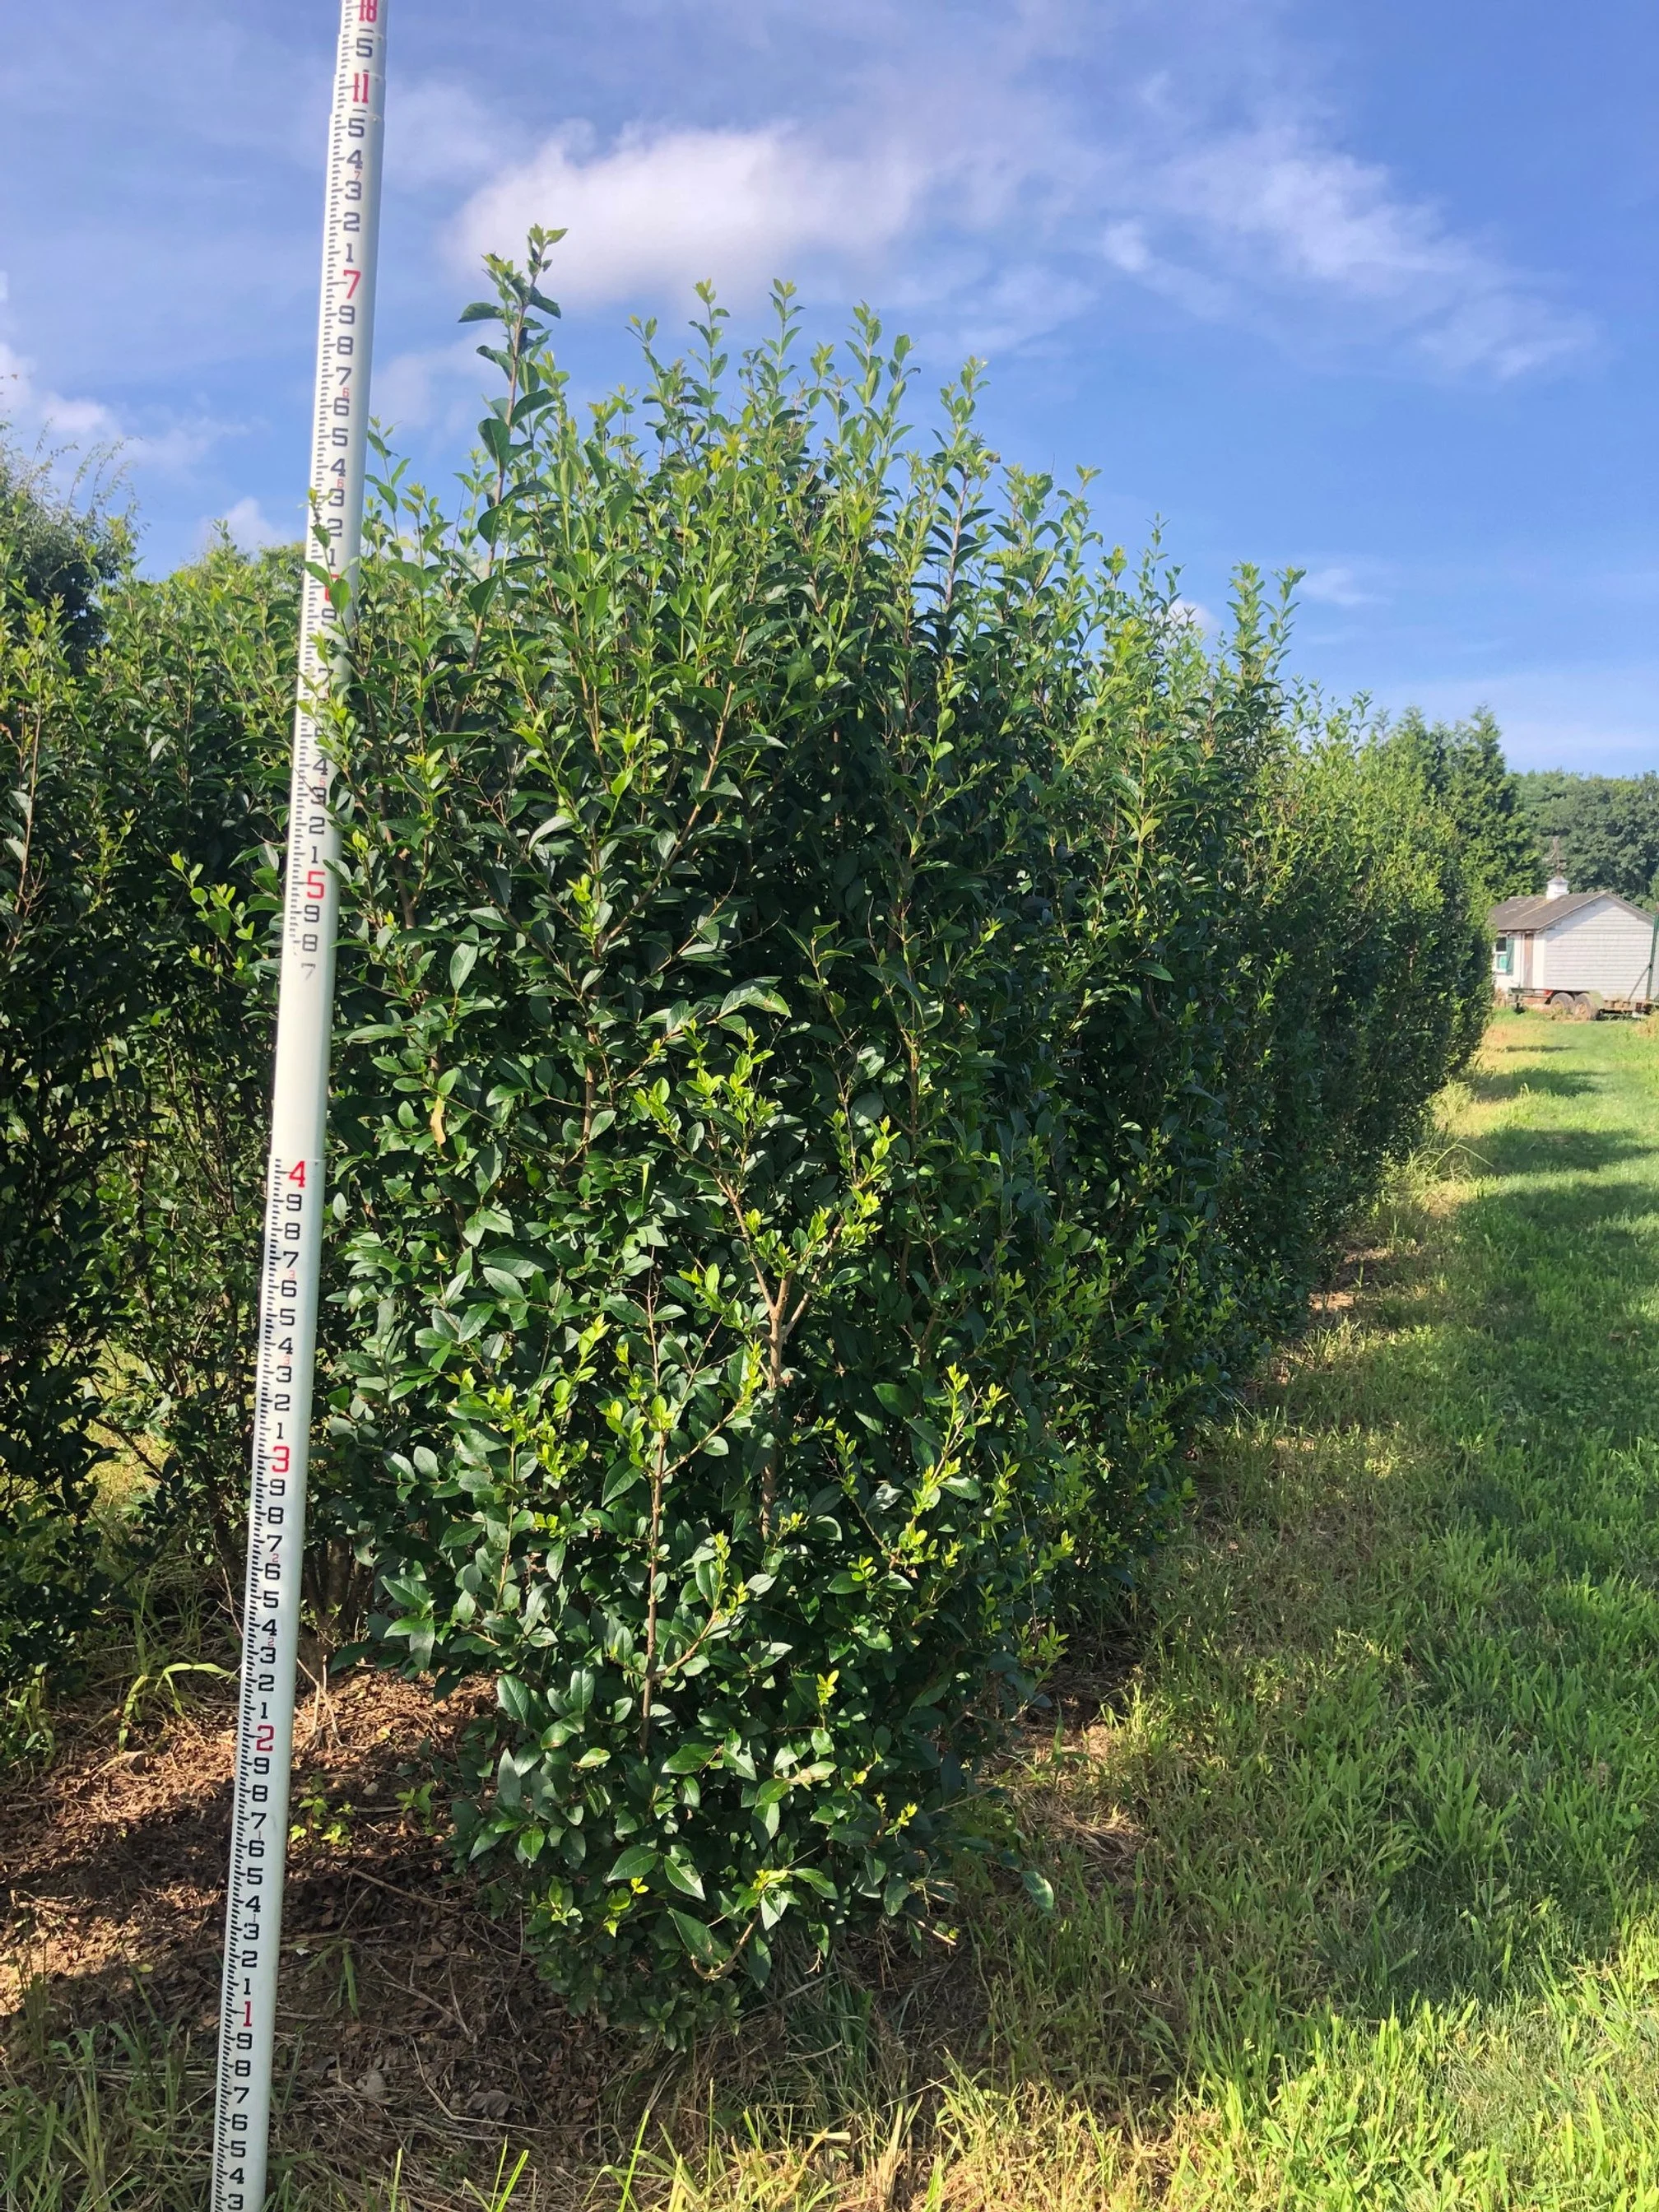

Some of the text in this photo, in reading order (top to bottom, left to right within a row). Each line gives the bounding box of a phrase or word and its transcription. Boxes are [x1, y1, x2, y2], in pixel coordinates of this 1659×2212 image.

[356, 38, 373, 58] 5
[353, 73, 369, 103] 11
[348, 118, 365, 137] 5
[346, 150, 363, 170] 4
[346, 180, 361, 201] 3
[343, 211, 360, 232] 2
[346, 243, 353, 263] 1
[343, 270, 360, 299] 7
[338, 304, 356, 325] 9
[337, 336, 354, 356] 8
[336, 367, 351, 385] 7
[342, 388, 350, 397] 6
[333, 397, 350, 416] 6
[332, 427, 348, 446] 5
[330, 458, 346, 476] 4
[328, 488, 344, 506] 3
[327, 518, 342, 537] 2
[328, 549, 336, 566] 1
[313, 756, 328, 775] 4
[309, 816, 325, 834] 2
[312, 846, 318, 863] 1
[306, 871, 325, 899] 5
[304, 905, 319, 922] 9
[302, 933, 318, 951] 8
[300, 963, 316, 981] 7
[289, 1160, 305, 1187] 4
[286, 1193, 302, 1211] 9
[285, 1222, 300, 1240] 8
[283, 1251, 299, 1268] 7
[281, 1280, 297, 1298] 6
[280, 1308, 295, 1326] 5
[278, 1337, 293, 1355] 4
[276, 1365, 291, 1382] 3
[275, 1393, 290, 1411] 2
[276, 1422, 284, 1439] 1
[272, 1446, 290, 1473] 3
[269, 1479, 285, 1496] 9
[268, 1507, 284, 1524] 8
[267, 1535, 282, 1552] 7
[272, 1554, 278, 1563] 2
[265, 1563, 281, 1580] 6
[263, 1590, 279, 1608] 5
[262, 1619, 277, 1636] 4
[268, 1638, 274, 1647] 2
[260, 1647, 276, 1665] 3
[258, 1674, 275, 1691] 2
[261, 1702, 267, 1719] 1
[257, 1725, 274, 1751] 2
[253, 1757, 270, 1775] 9
[252, 1784, 268, 1802] 8
[251, 1812, 267, 1829] 7
[249, 1840, 265, 1857] 6
[247, 1868, 263, 1885] 5
[245, 1895, 261, 1912] 4
[244, 1922, 259, 1940] 3
[242, 1950, 258, 1968] 2
[244, 1978, 251, 1996] 1
[243, 2001, 252, 2027] 1
[236, 2033, 253, 2050] 9
[235, 2060, 251, 2077] 8
[234, 2087, 249, 2103] 7
[231, 2113, 248, 2131] 6
[230, 2140, 246, 2158] 5
[230, 2168, 244, 2185] 4
[228, 2193, 244, 2211] 3
